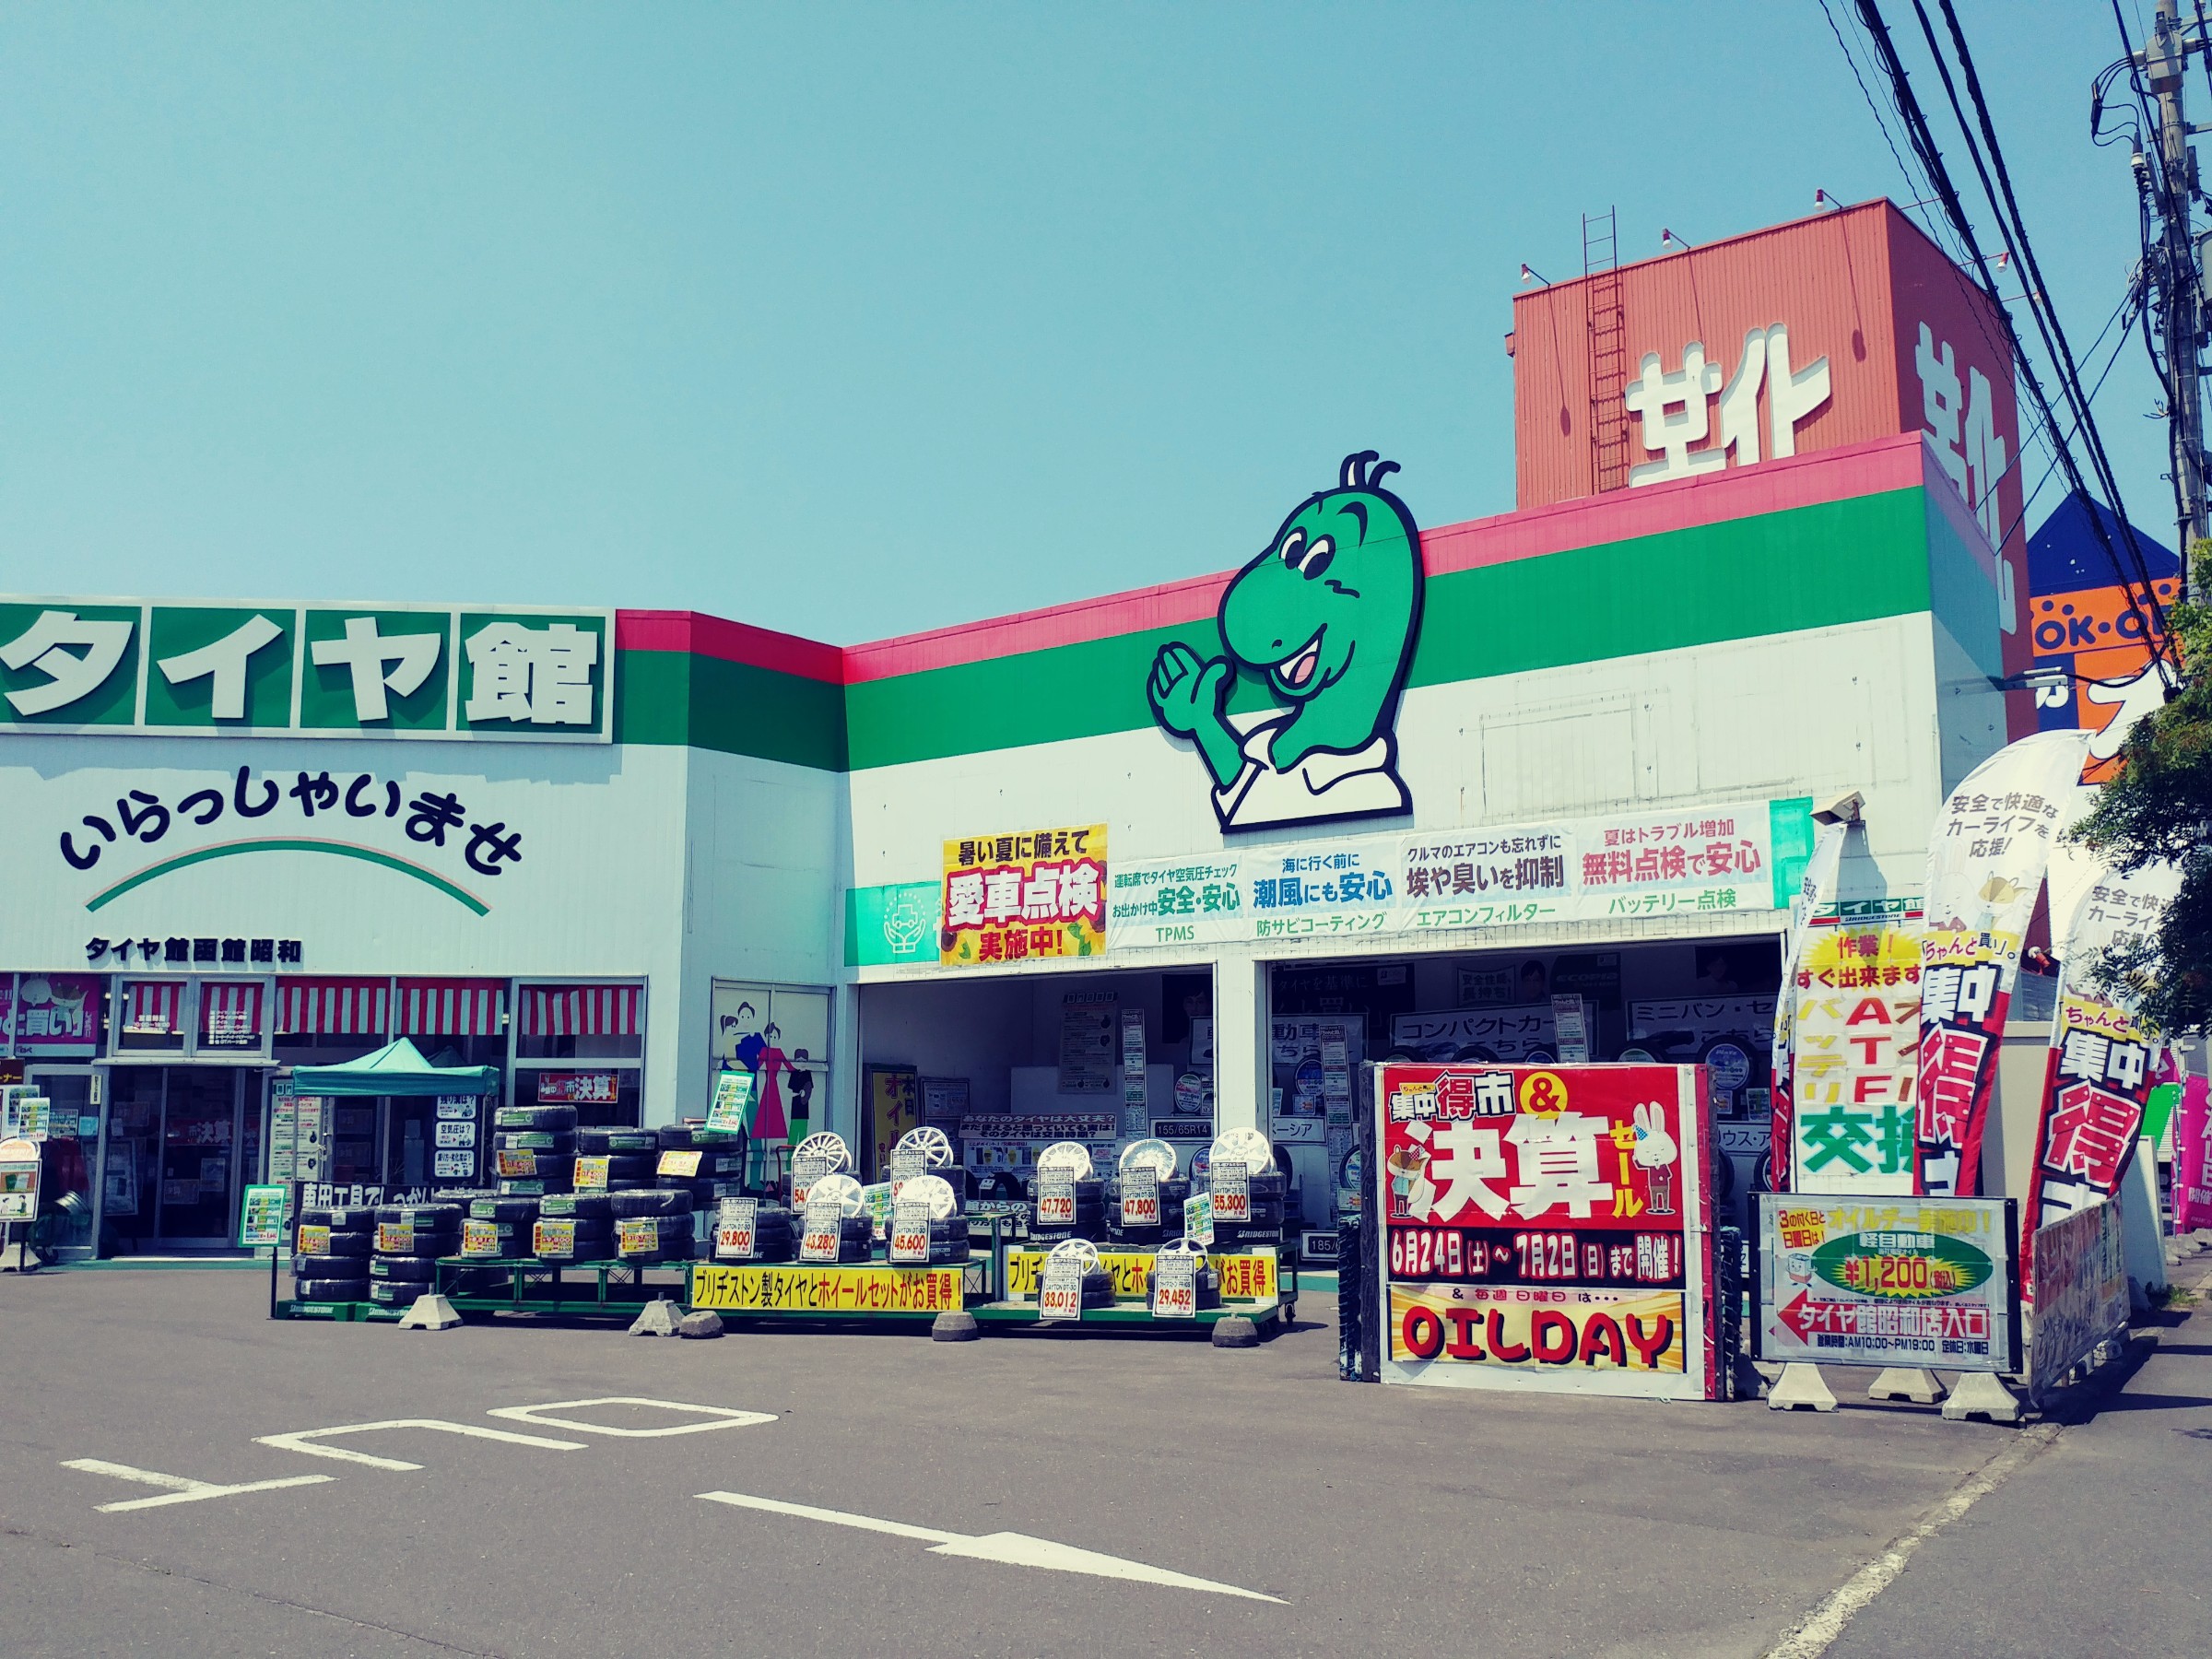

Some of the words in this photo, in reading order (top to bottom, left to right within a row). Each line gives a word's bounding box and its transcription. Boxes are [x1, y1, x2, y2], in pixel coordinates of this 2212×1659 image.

[0, 609, 598, 725] タイヤ館
[1951, 792, 2058, 819] 安全で快適な
[60, 765, 523, 876] いらっしゃいませ
[1604, 818, 1735, 846] 夏はトラブル増加
[1946, 815, 2050, 840] カーライフを
[959, 829, 1089, 867] 暑い夏に備えて
[1407, 835, 1561, 863] クルマのエアコンも忘れずに
[1969, 836, 2012, 859] 応援!
[1282, 853, 1359, 874] 海に行く前に
[1583, 839, 1760, 886] 無料点検で安心
[1114, 863, 1237, 888] 運転席でタイヤ空気圧チェック
[1406, 854, 1564, 899] 埃や臭いを抑制
[947, 865, 1102, 927] 愛車点検
[1253, 870, 1393, 909] 潮風にも安心
[1609, 888, 1735, 914] バッテリー点検
[1256, 911, 1387, 937] 防サビコーティング
[1417, 903, 1555, 927] エアコンフィルター
[979, 927, 1063, 961] 実施中!
[1156, 925, 1194, 943] TPMS
[1838, 934, 1893, 959] 作業!
[86, 937, 302, 963] タイヤ館函館昭和
[1797, 964, 1921, 989] すぐ出来ます
[575, 1076, 611, 1100] 決算
[1529, 1078, 1560, 1112] &
[1158, 1124, 1208, 1136] 155/65R14
[1405, 1112, 1614, 1222] 決算
[1610, 1121, 1643, 1218] セール
[1041, 1198, 1073, 1215] 47,720
[1124, 1199, 1156, 1217] 47,800
[1214, 1194, 1246, 1212] 55,300
[1779, 1209, 1826, 1228] 3の付く日と
[721, 1230, 750, 1247] 29,800
[805, 1234, 836, 1250] 43,280
[895, 1234, 926, 1251] 45,600
[1859, 1233, 1935, 1249] 軽自動車
[1844, 1255, 1927, 1290] ¥1,200
[1044, 1291, 1077, 1308] 33,012
[1159, 1289, 1192, 1306] 29,452
[1798, 1302, 1988, 1338] タイヤ館昭和店入口
[1402, 1306, 1674, 1368] OILDAY
